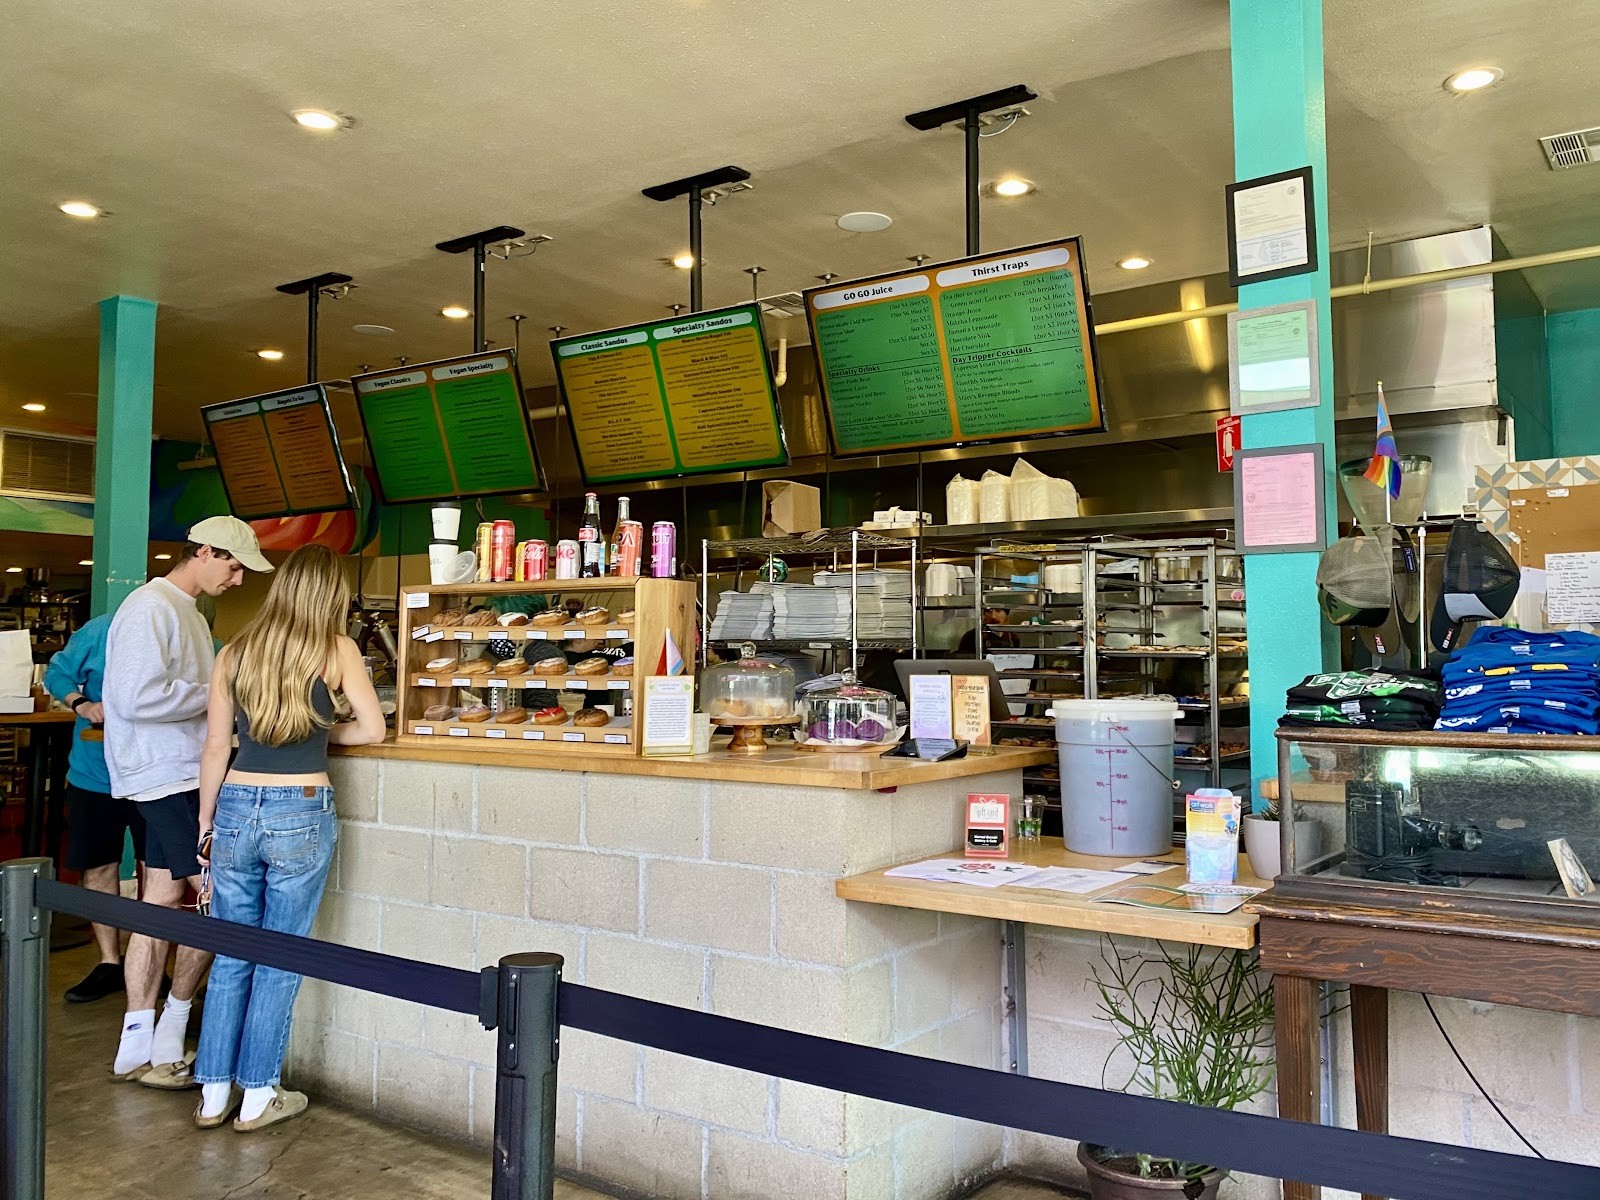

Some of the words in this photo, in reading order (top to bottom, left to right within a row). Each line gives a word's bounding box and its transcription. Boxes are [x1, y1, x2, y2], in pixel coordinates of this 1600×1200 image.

[971, 264, 1001, 278] Thirst
[1001, 258, 1029, 272] Traps
[843, 291, 855, 300] GO
[857, 289, 869, 298] GO
[870, 284, 893, 295] Juice
[1037, 282, 1067, 294] breakfast
[968, 313, 998, 323] Lemonade
[672, 322, 705, 334] Specialty
[706, 317, 732, 328] Sandos
[971, 321, 1001, 331] Lemonade
[580, 341, 603, 350] Classic
[604, 337, 627, 346] Sandos
[948, 334, 976, 343] Chocolate
[961, 341, 990, 350] Chocolate
[952, 355, 967, 364] Day
[967, 351, 995, 362] Tripper
[996, 346, 1032, 358] Cocktails
[449, 367, 467, 375] Vegan
[467, 362, 493, 372] Specialty
[827, 368, 857, 378] Specialty
[858, 364, 880, 373] Drinks
[952, 362, 978, 372] Espresso
[390, 376, 411, 385] Classics
